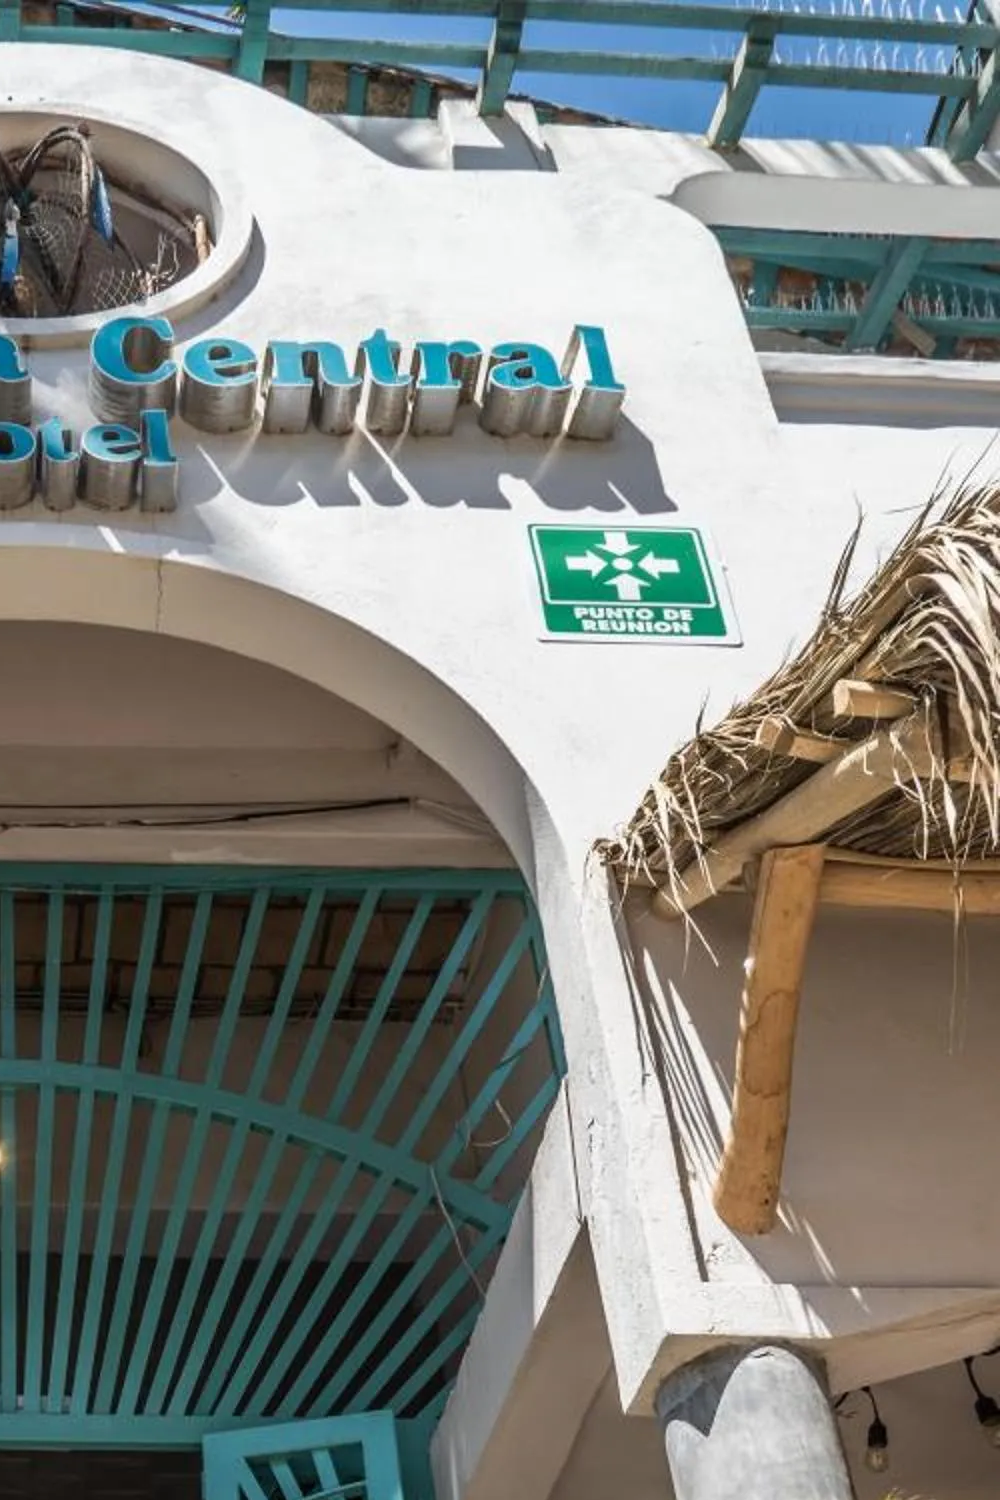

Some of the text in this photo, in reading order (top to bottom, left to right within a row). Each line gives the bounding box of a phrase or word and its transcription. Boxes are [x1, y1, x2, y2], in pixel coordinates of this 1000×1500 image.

[90, 315, 626, 391] Central
[573, 606, 694, 621] PUNTO DE
[581, 619, 691, 634] REUNION
